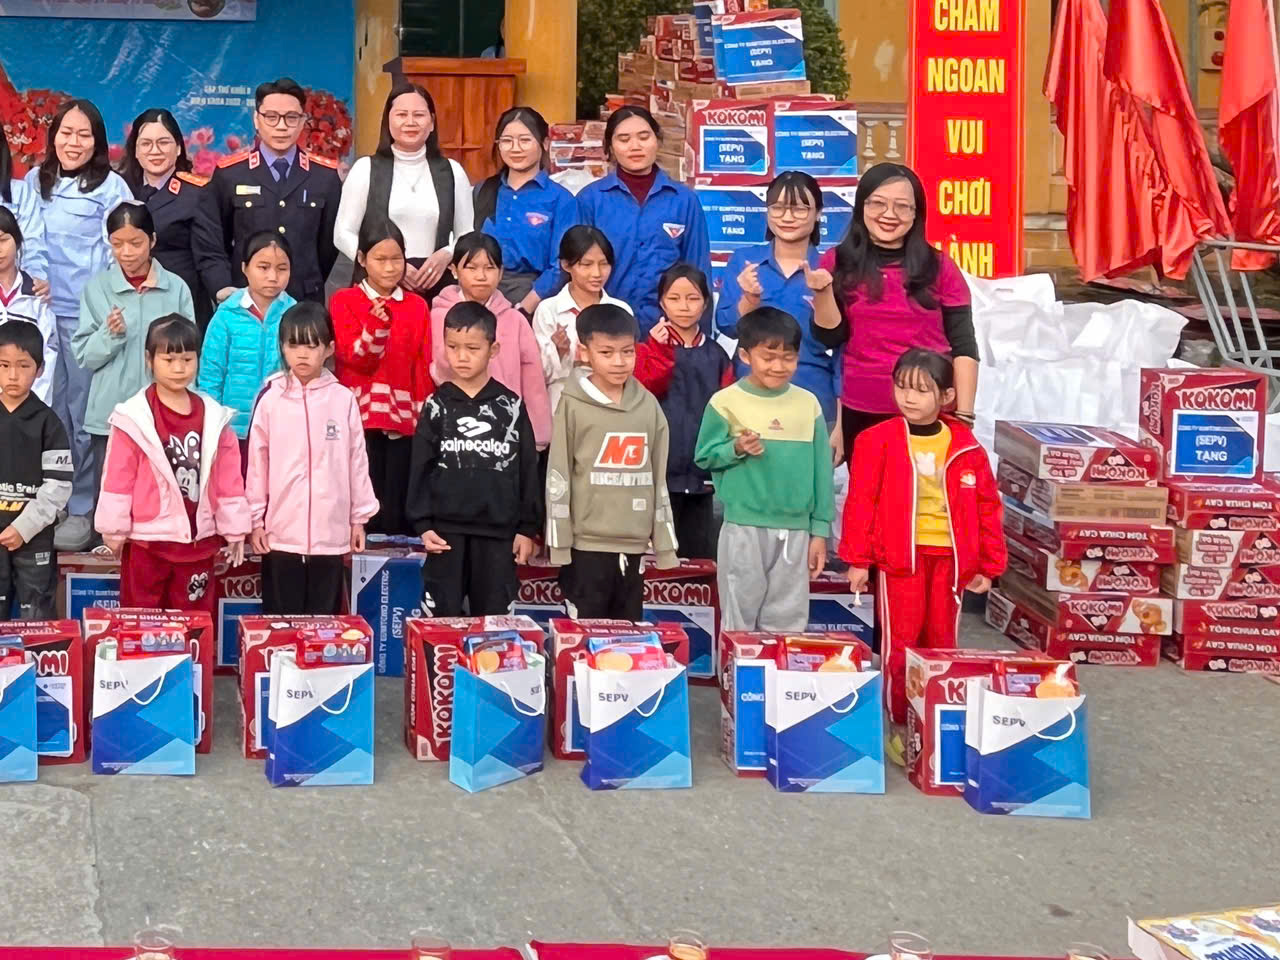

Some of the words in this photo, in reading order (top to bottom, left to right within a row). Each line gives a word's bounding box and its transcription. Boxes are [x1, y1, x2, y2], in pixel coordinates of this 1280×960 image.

[928, 57, 1005, 94] NGOAN
[706, 110, 766, 126] KOKOMI
[947, 120, 983, 154] VUI
[939, 177, 991, 216] CHƠI
[935, 233, 993, 278] ÀNH
[1181, 389, 1256, 409] KOKOMI
[598, 692, 629, 703] SEPV
